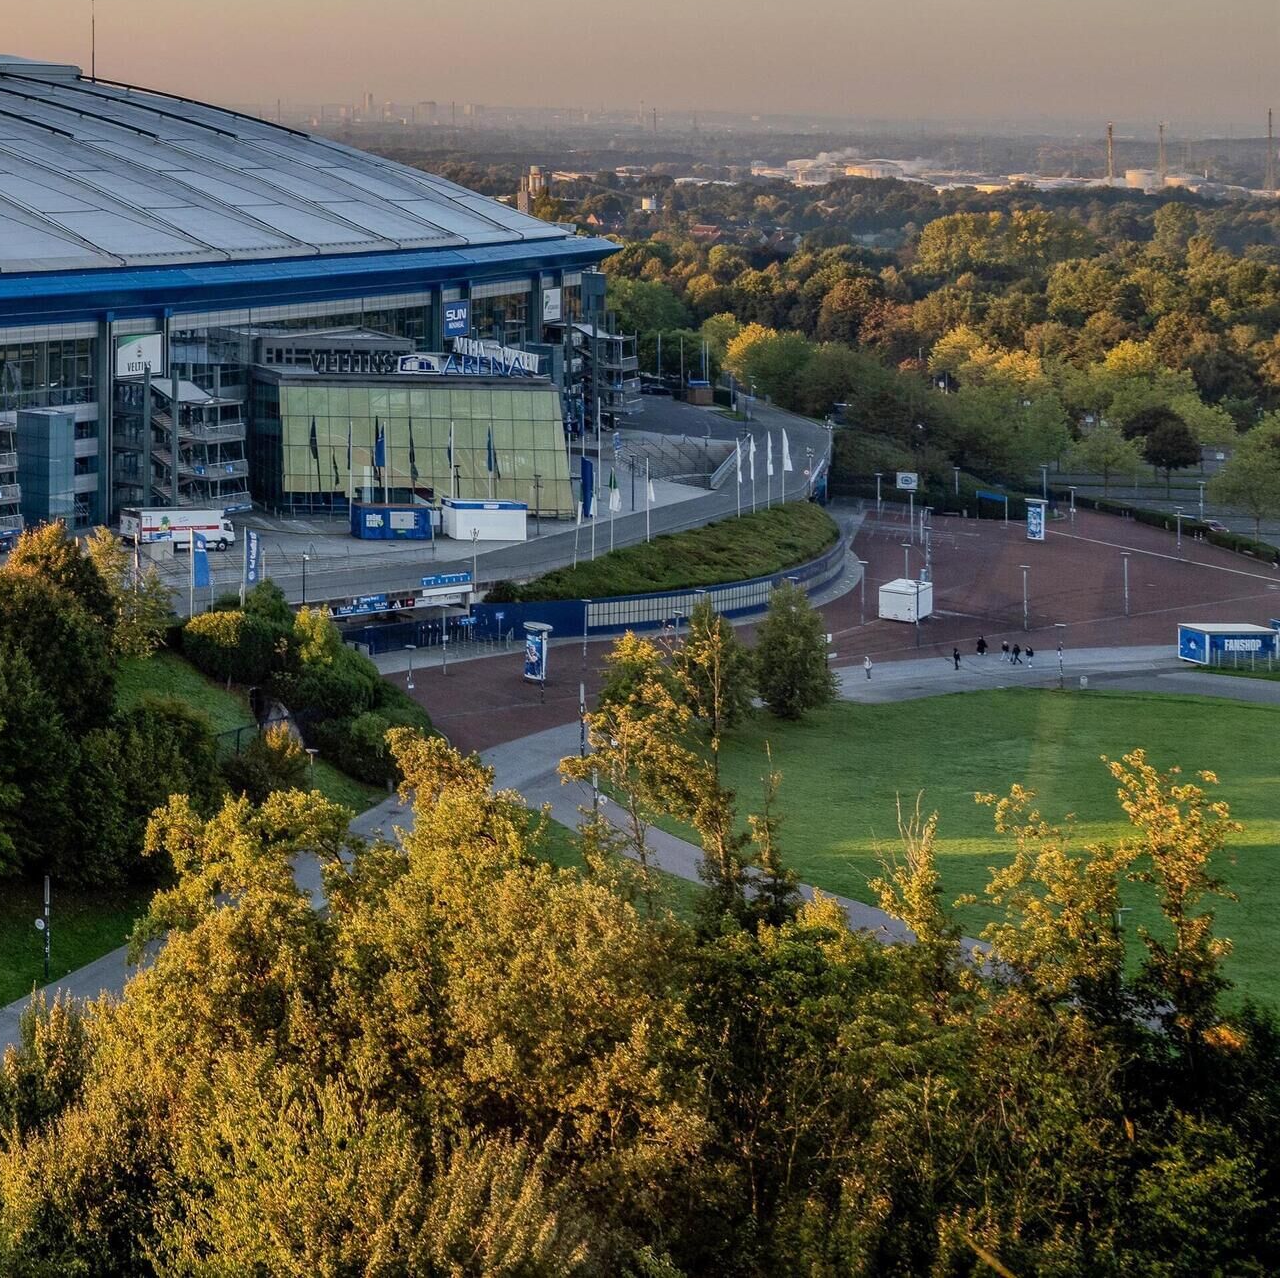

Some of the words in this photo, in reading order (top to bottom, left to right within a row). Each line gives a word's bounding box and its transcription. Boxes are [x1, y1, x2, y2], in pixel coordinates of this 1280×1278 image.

[446, 308, 467, 321] SUN
[309, 353, 394, 374] VELTINS
[443, 354, 527, 376] ARENA
[1224, 639, 1262, 651] FANSHOP
